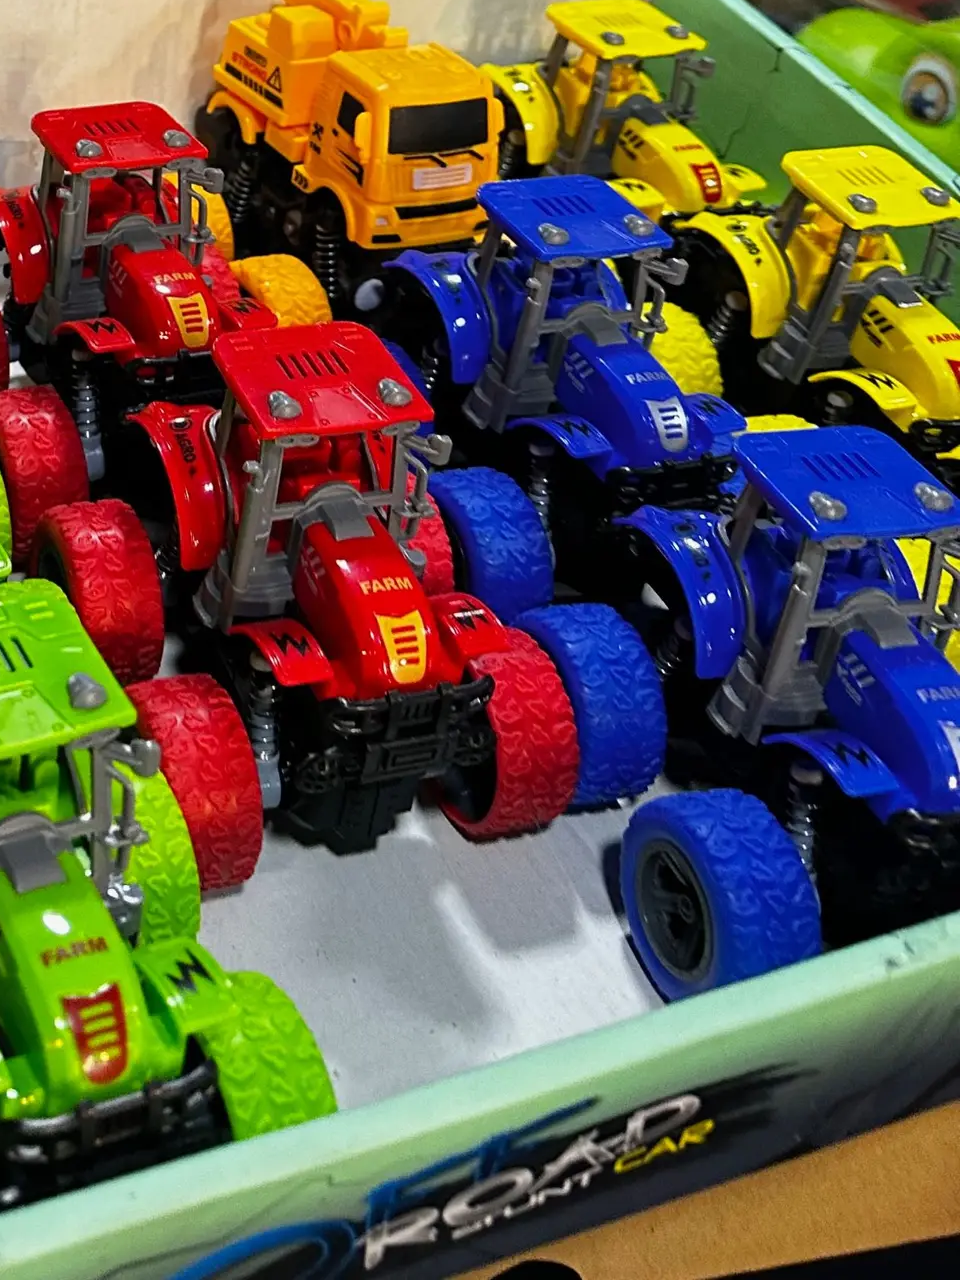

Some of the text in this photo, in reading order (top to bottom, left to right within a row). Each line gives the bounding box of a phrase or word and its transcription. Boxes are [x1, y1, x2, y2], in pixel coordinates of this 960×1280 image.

[154, 271, 196, 285] FARM
[625, 371, 670, 385] FARM
[360, 576, 414, 596] FARM
[40, 936, 110, 968] FARM
[613, 1119, 715, 1174] CAR
[358, 1093, 702, 1271] ROAD
